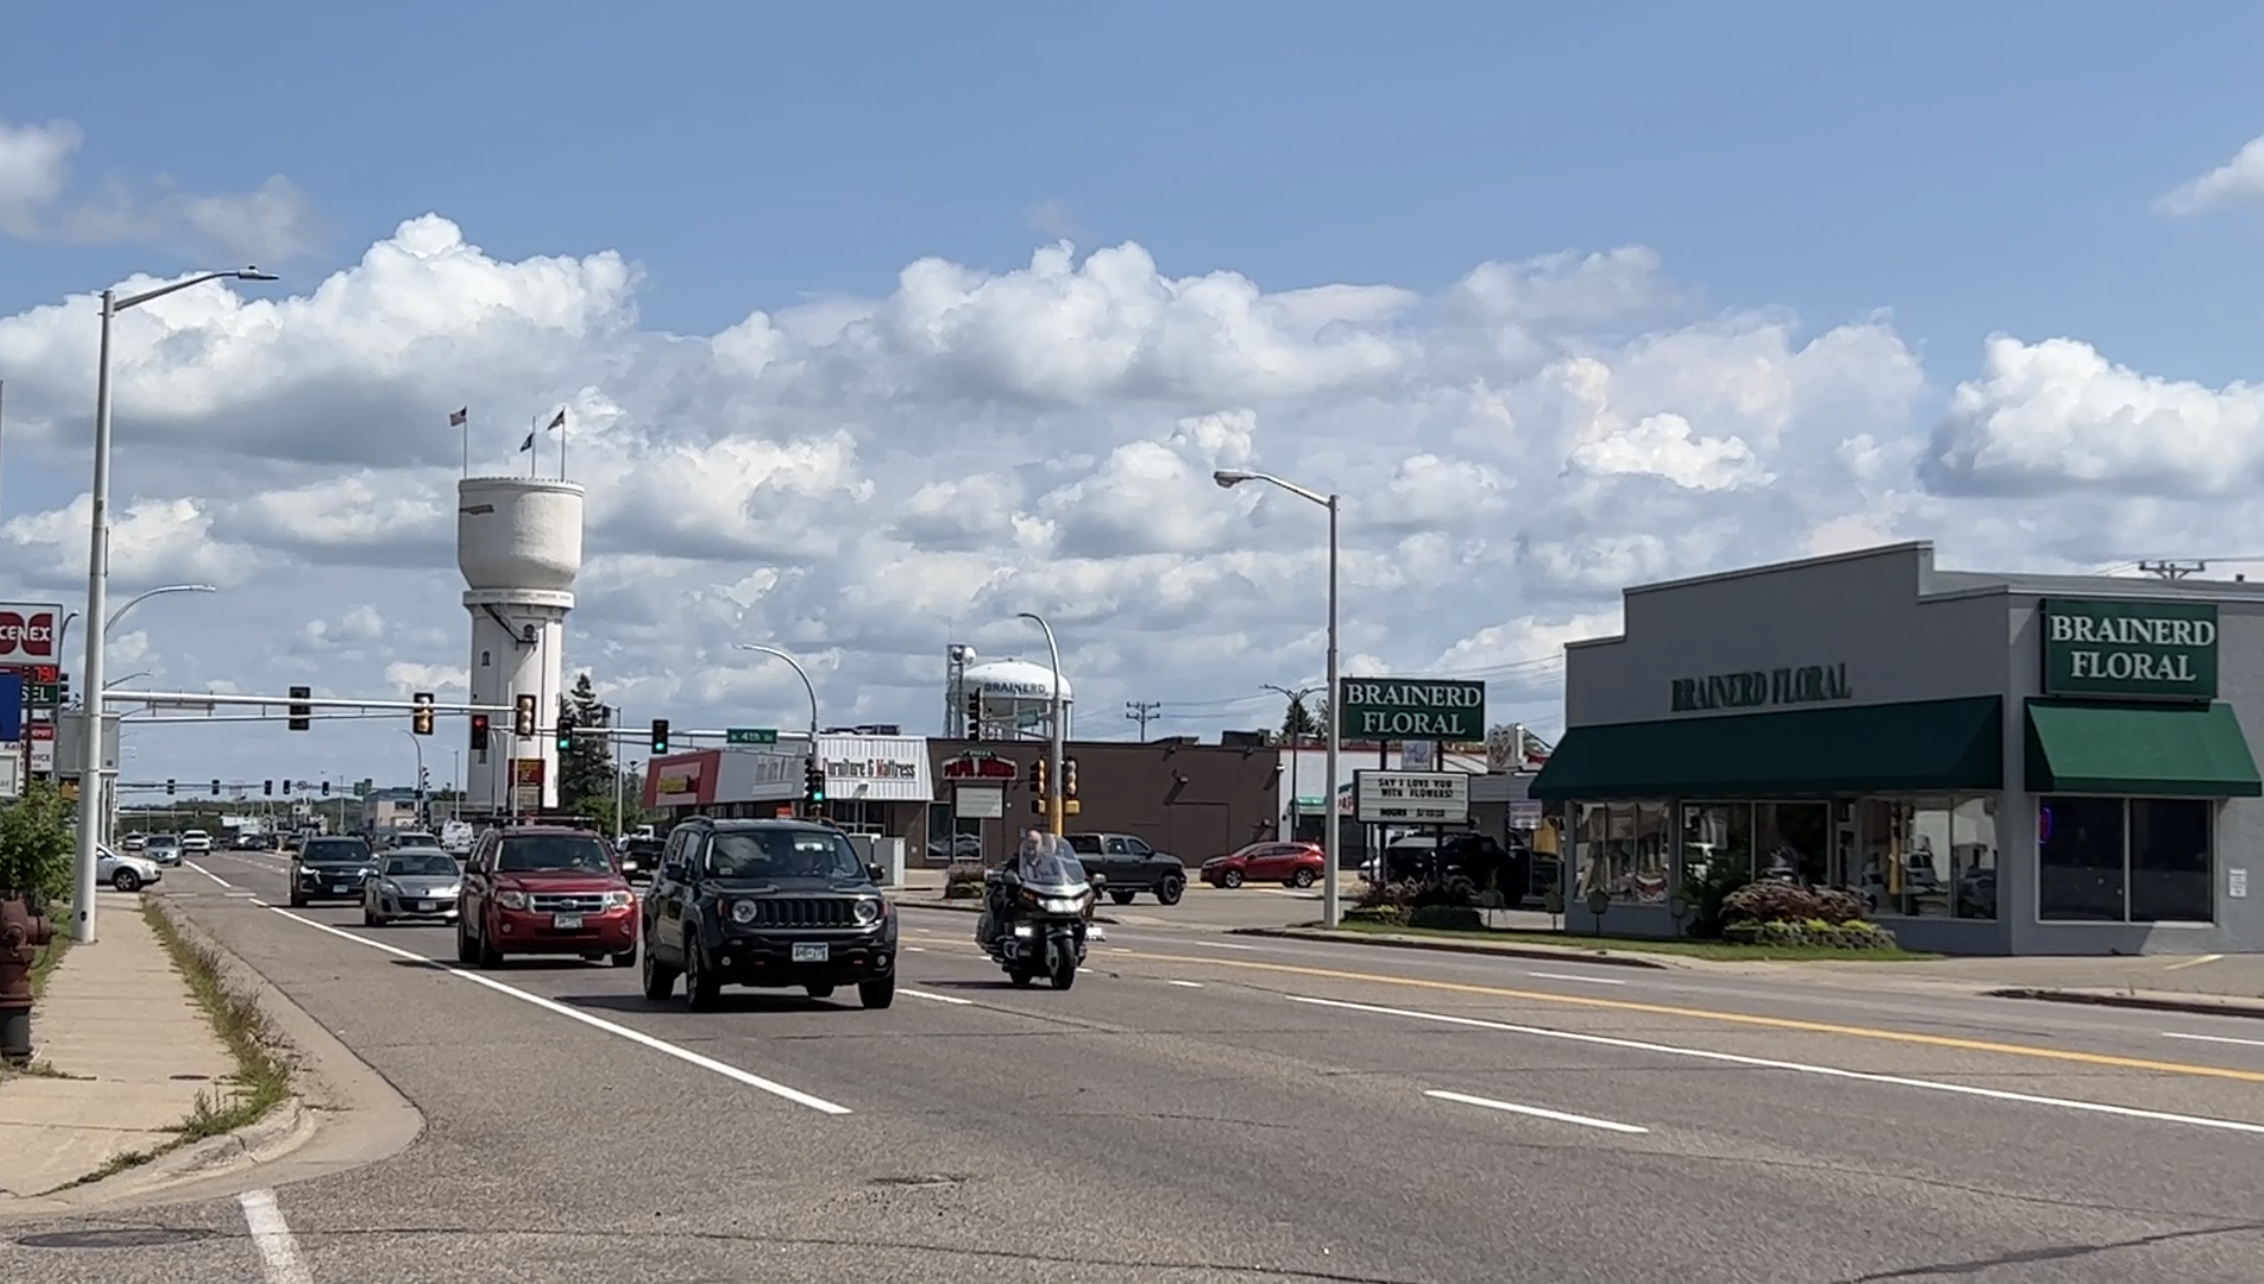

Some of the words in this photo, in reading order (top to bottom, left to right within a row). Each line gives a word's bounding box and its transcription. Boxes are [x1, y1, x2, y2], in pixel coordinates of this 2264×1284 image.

[0, 625, 51, 642] CENEX
[2050, 615, 2215, 646] BRAINERD
[2070, 651, 2197, 681] FLORAL
[984, 682, 1046, 694] BRAINERD
[1347, 684, 1482, 707] BRAINERD
[1671, 671, 1767, 712] BRAINERD
[1772, 662, 1852, 704] FLORAL
[1362, 711, 1466, 735] FLORAL
[1379, 778, 1397, 787] SAY
[1407, 779, 1429, 788] LOVE
[1434, 780, 1453, 789] YOU
[1381, 788, 1404, 798] WITH
